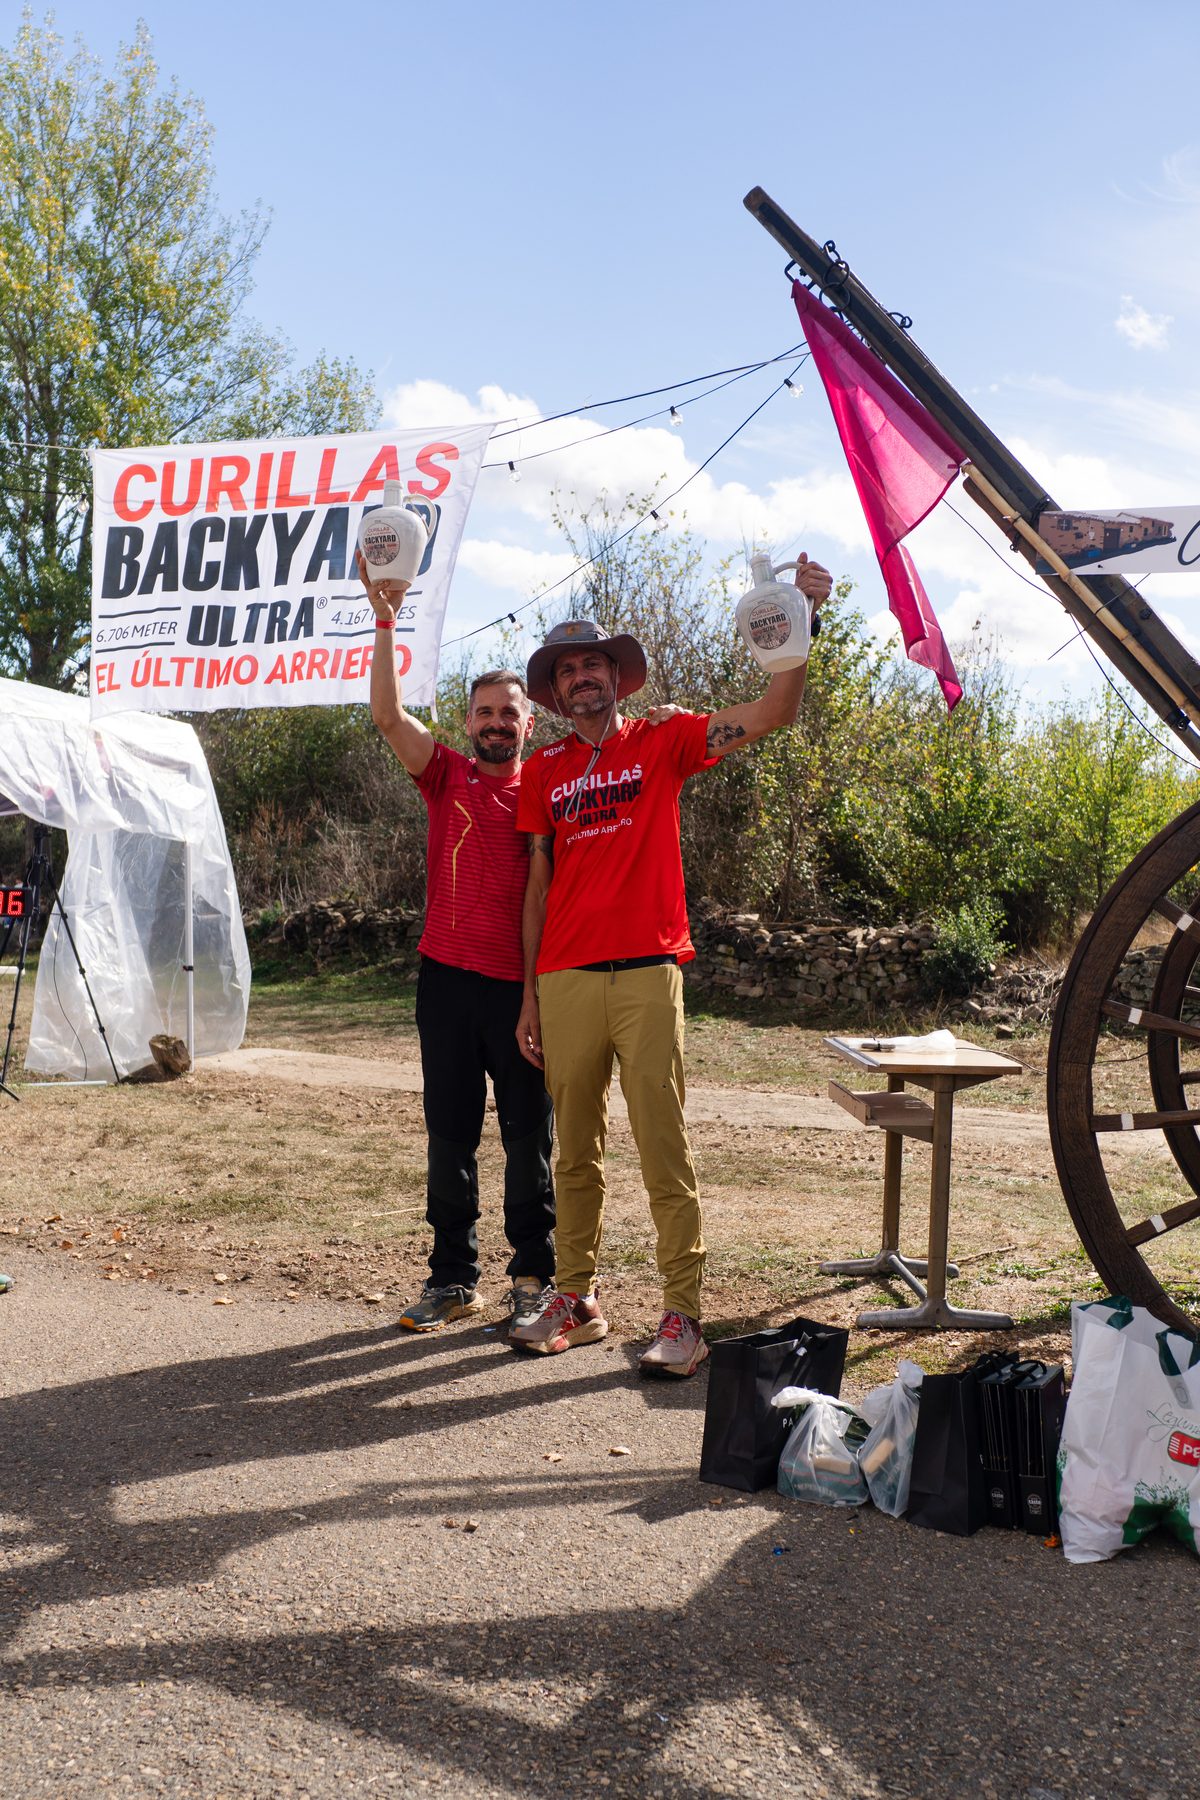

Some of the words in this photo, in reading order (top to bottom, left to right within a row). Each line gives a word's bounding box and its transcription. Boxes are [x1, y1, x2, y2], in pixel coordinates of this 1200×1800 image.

[114, 442, 460, 522] CURILLAS
[365, 535, 396, 545] BACKYARD
[331, 608, 370, 626] 4.167
[750, 613, 786, 629] BACKYARD
[96, 625, 131, 643] 6.706
[131, 621, 178, 638] METER
[95, 662, 121, 695] EL
[130, 650, 259, 689] ÚLTIMO
[551, 763, 643, 803] CURILLAS
[578, 807, 618, 827] ULTRA
[0, 891, 22, 915] 6
